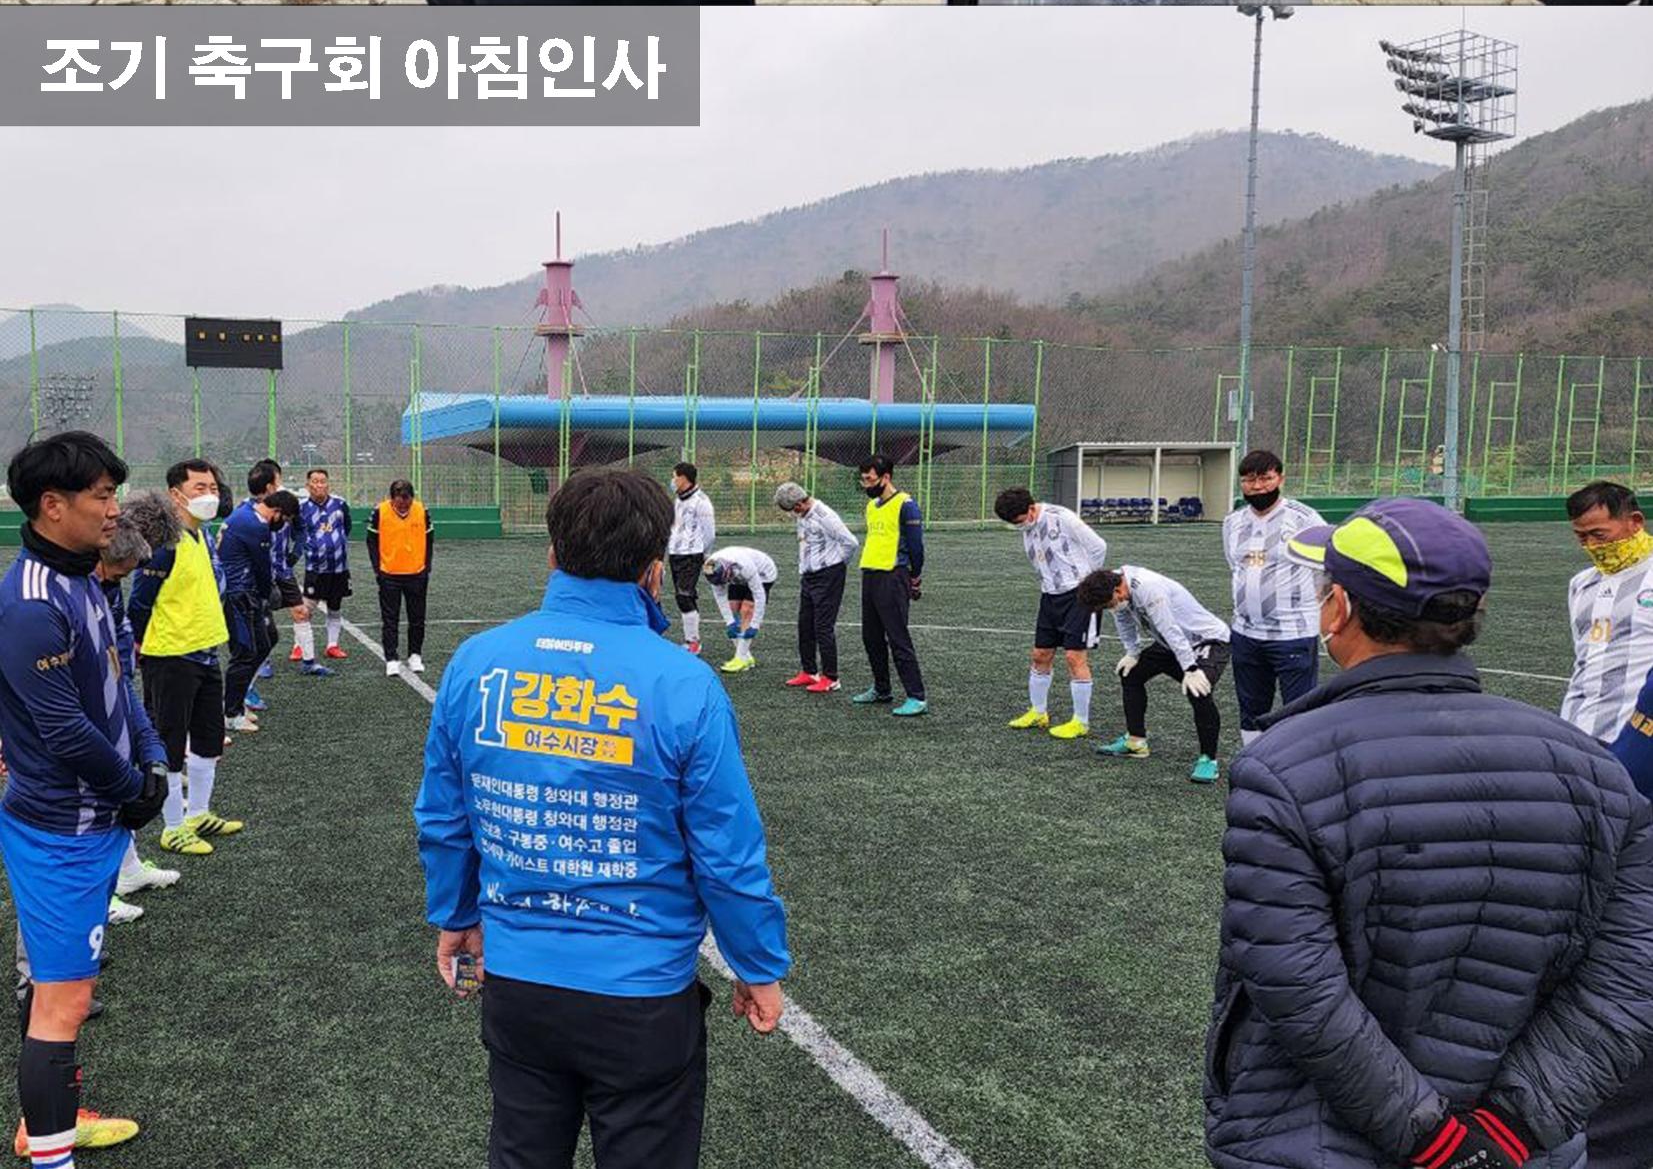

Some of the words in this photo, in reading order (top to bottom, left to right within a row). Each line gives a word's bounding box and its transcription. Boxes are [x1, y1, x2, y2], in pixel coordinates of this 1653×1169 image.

[511, 671, 639, 730] 강화수
[524, 729, 599, 757] 여수시장
[544, 786, 588, 807] 청와대
[592, 791, 639, 811] 행정관
[543, 810, 588, 831] 청와대
[592, 815, 638, 833] 행정관
[608, 838, 637, 854] 졸업
[553, 859, 594, 877] 대학원
[597, 861, 638, 878] 재학중
[89, 925, 105, 961] 9
